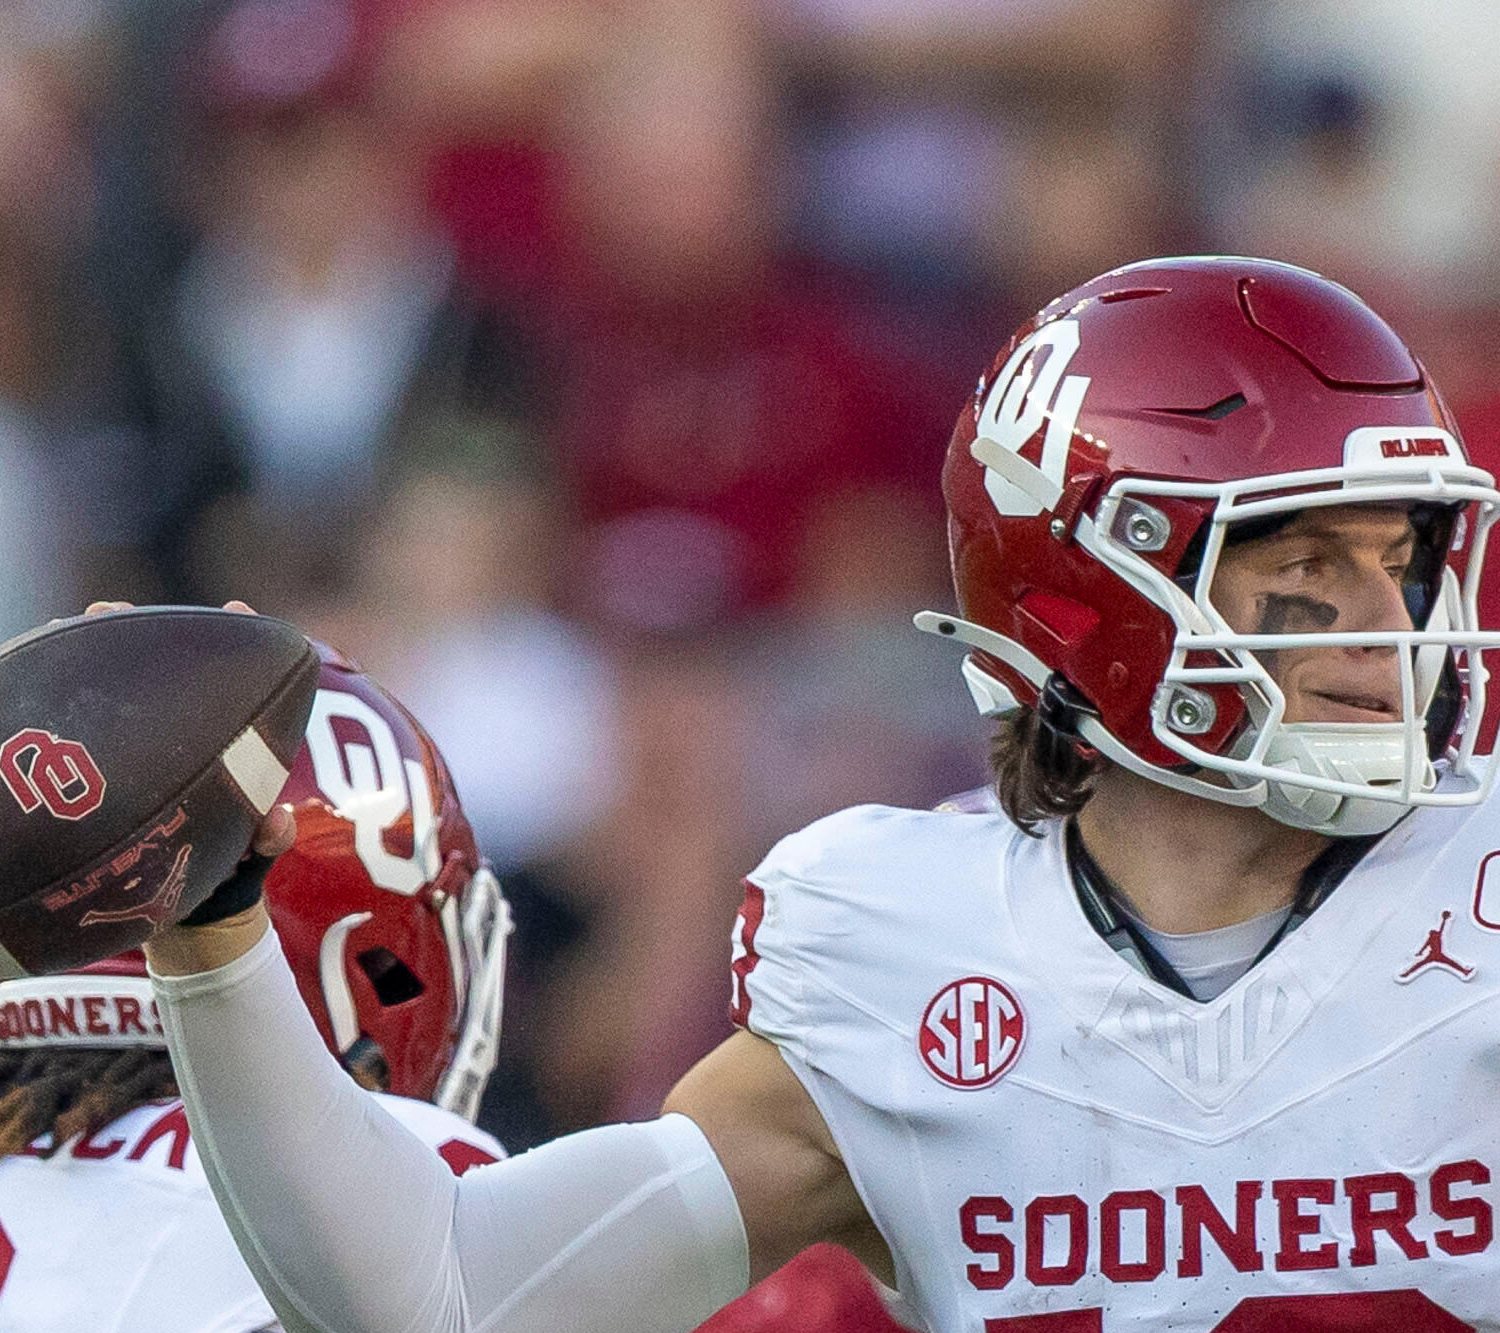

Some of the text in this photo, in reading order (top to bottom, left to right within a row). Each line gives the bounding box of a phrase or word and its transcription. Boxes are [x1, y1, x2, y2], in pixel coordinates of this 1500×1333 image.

[306, 688, 442, 896] OU
[924, 982, 1018, 1080] SEC
[959, 1159, 1494, 1290] SOONERS
